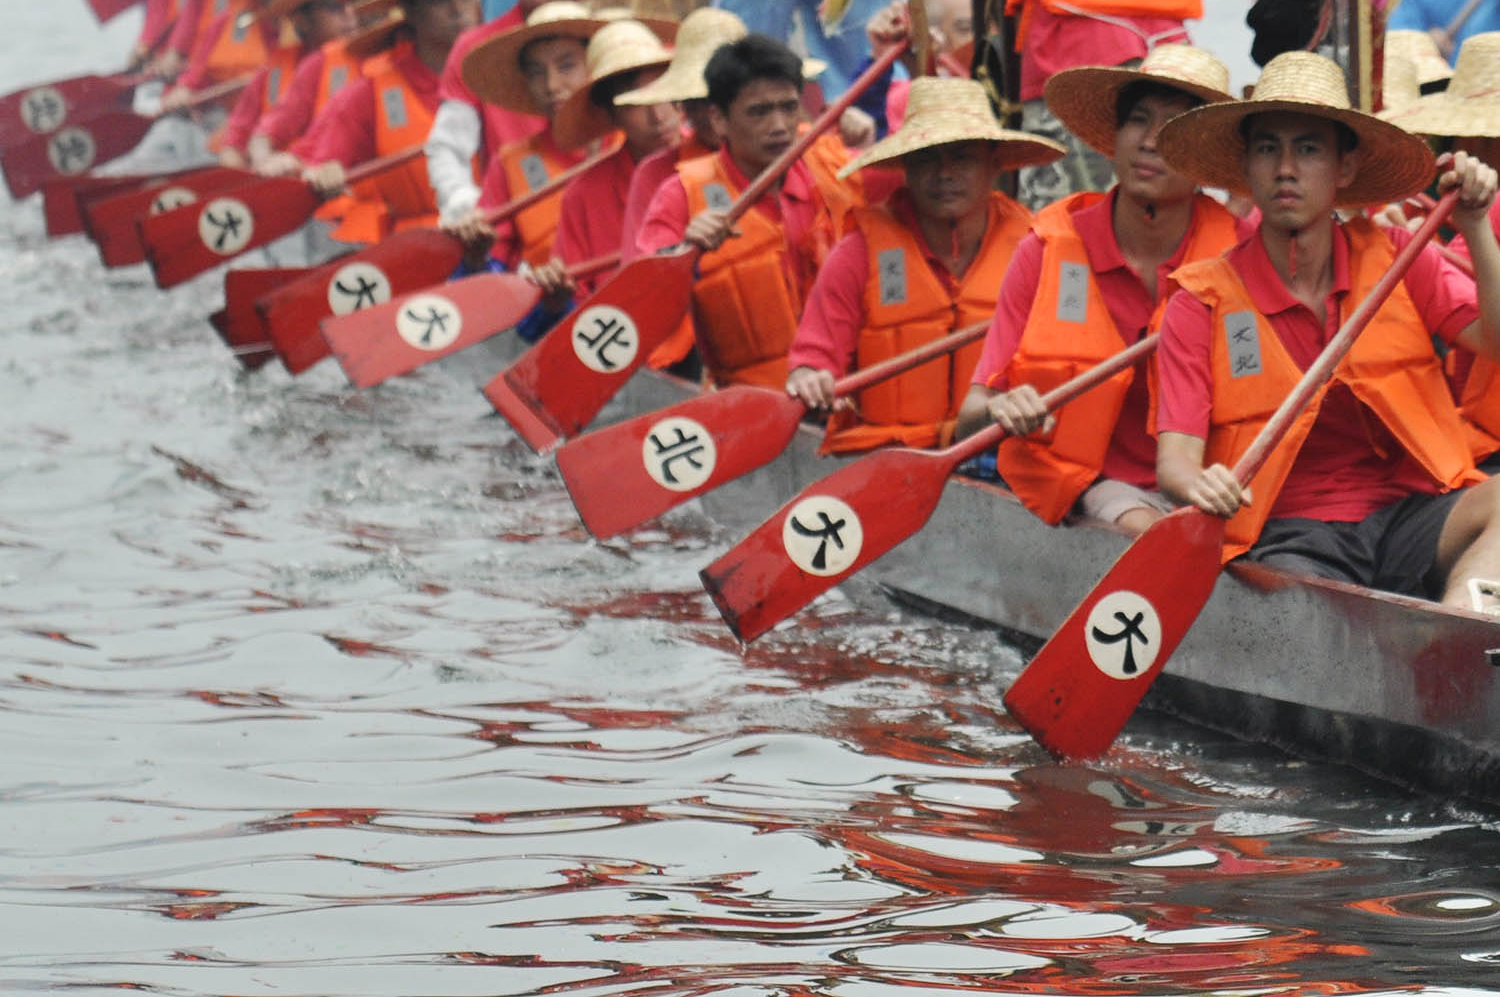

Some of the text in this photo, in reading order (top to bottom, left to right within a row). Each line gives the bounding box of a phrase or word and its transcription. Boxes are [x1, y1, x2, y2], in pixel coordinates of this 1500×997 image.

[406, 306, 449, 347] 大
[577, 318, 630, 369] 北
[650, 427, 705, 483] 北
[791, 511, 846, 570] 大
[1091, 610, 1149, 672] 大
